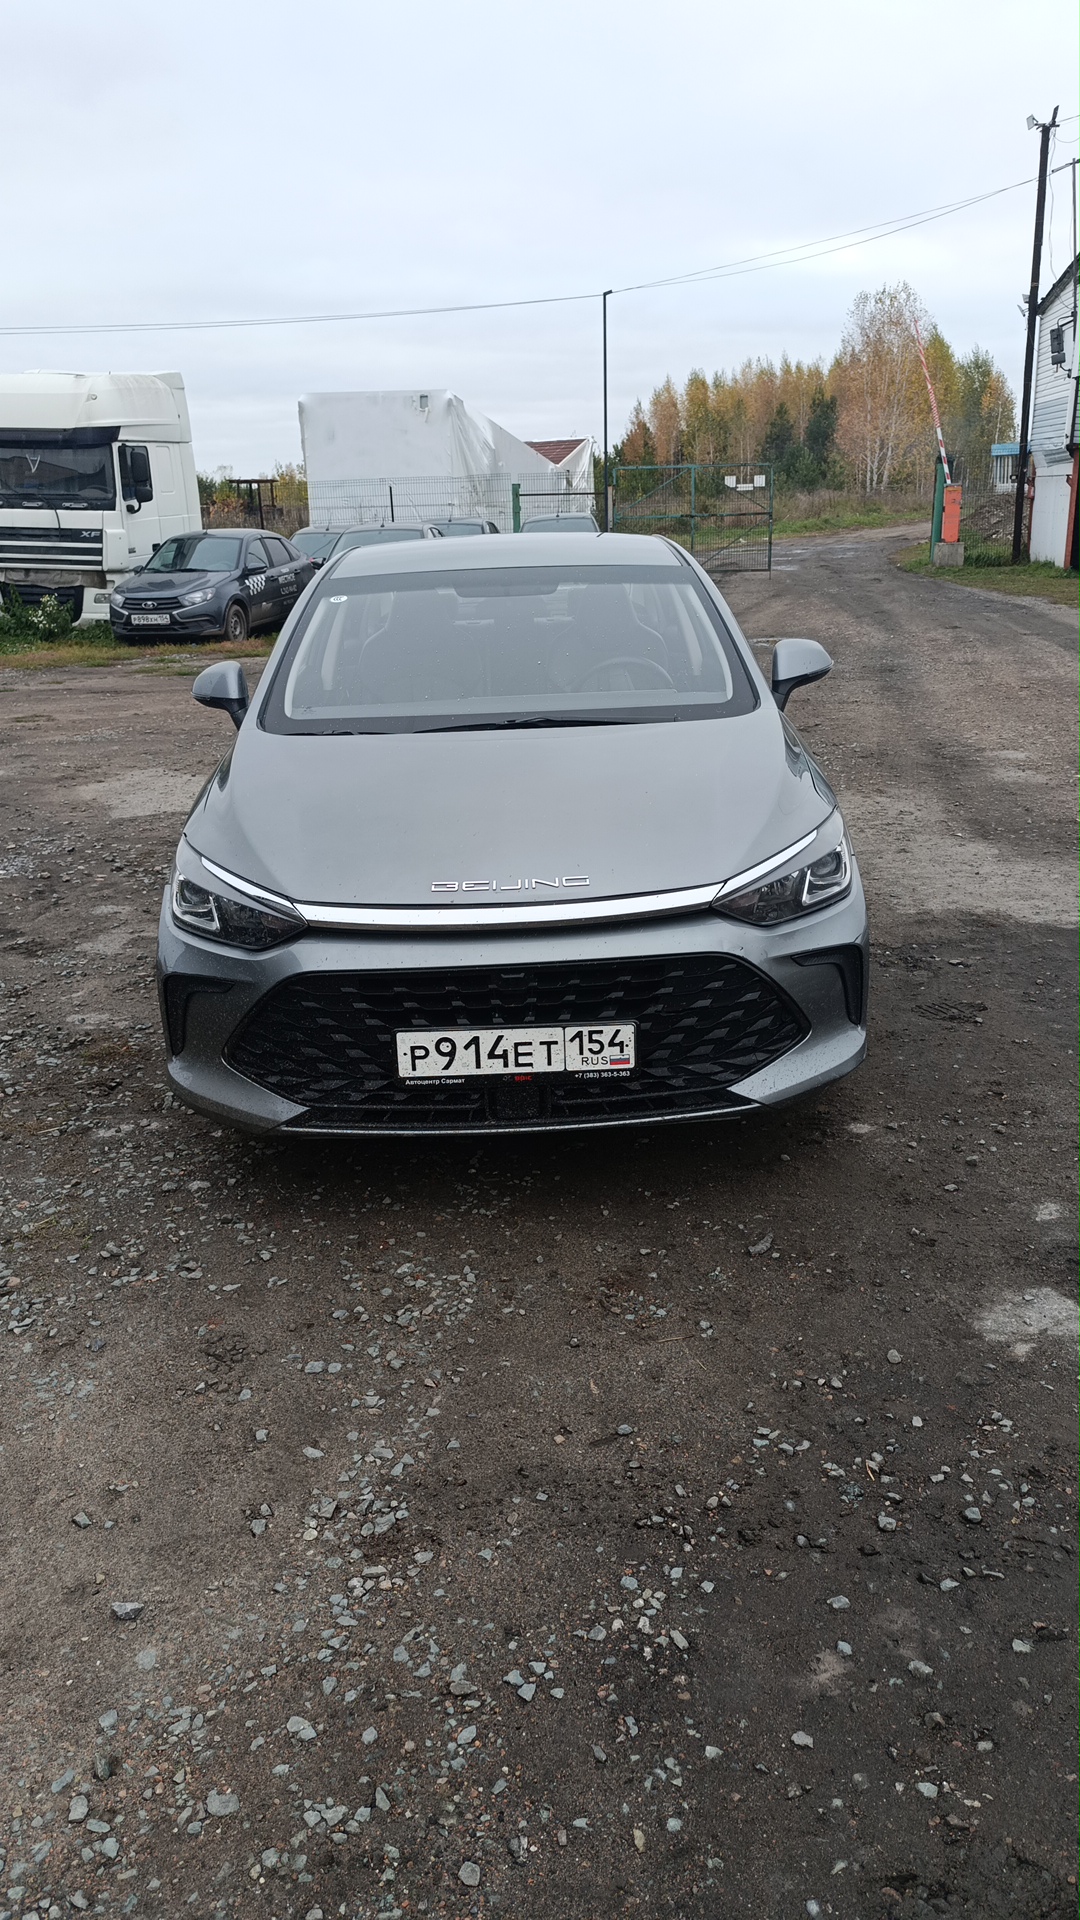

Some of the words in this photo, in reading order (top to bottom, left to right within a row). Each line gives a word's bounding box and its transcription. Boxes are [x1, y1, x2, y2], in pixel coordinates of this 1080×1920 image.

[80, 530, 101, 538] XF
[431, 875, 590, 892] BEIJING
[569, 1029, 625, 1056] 154
[581, 1055, 609, 1066] RUS
